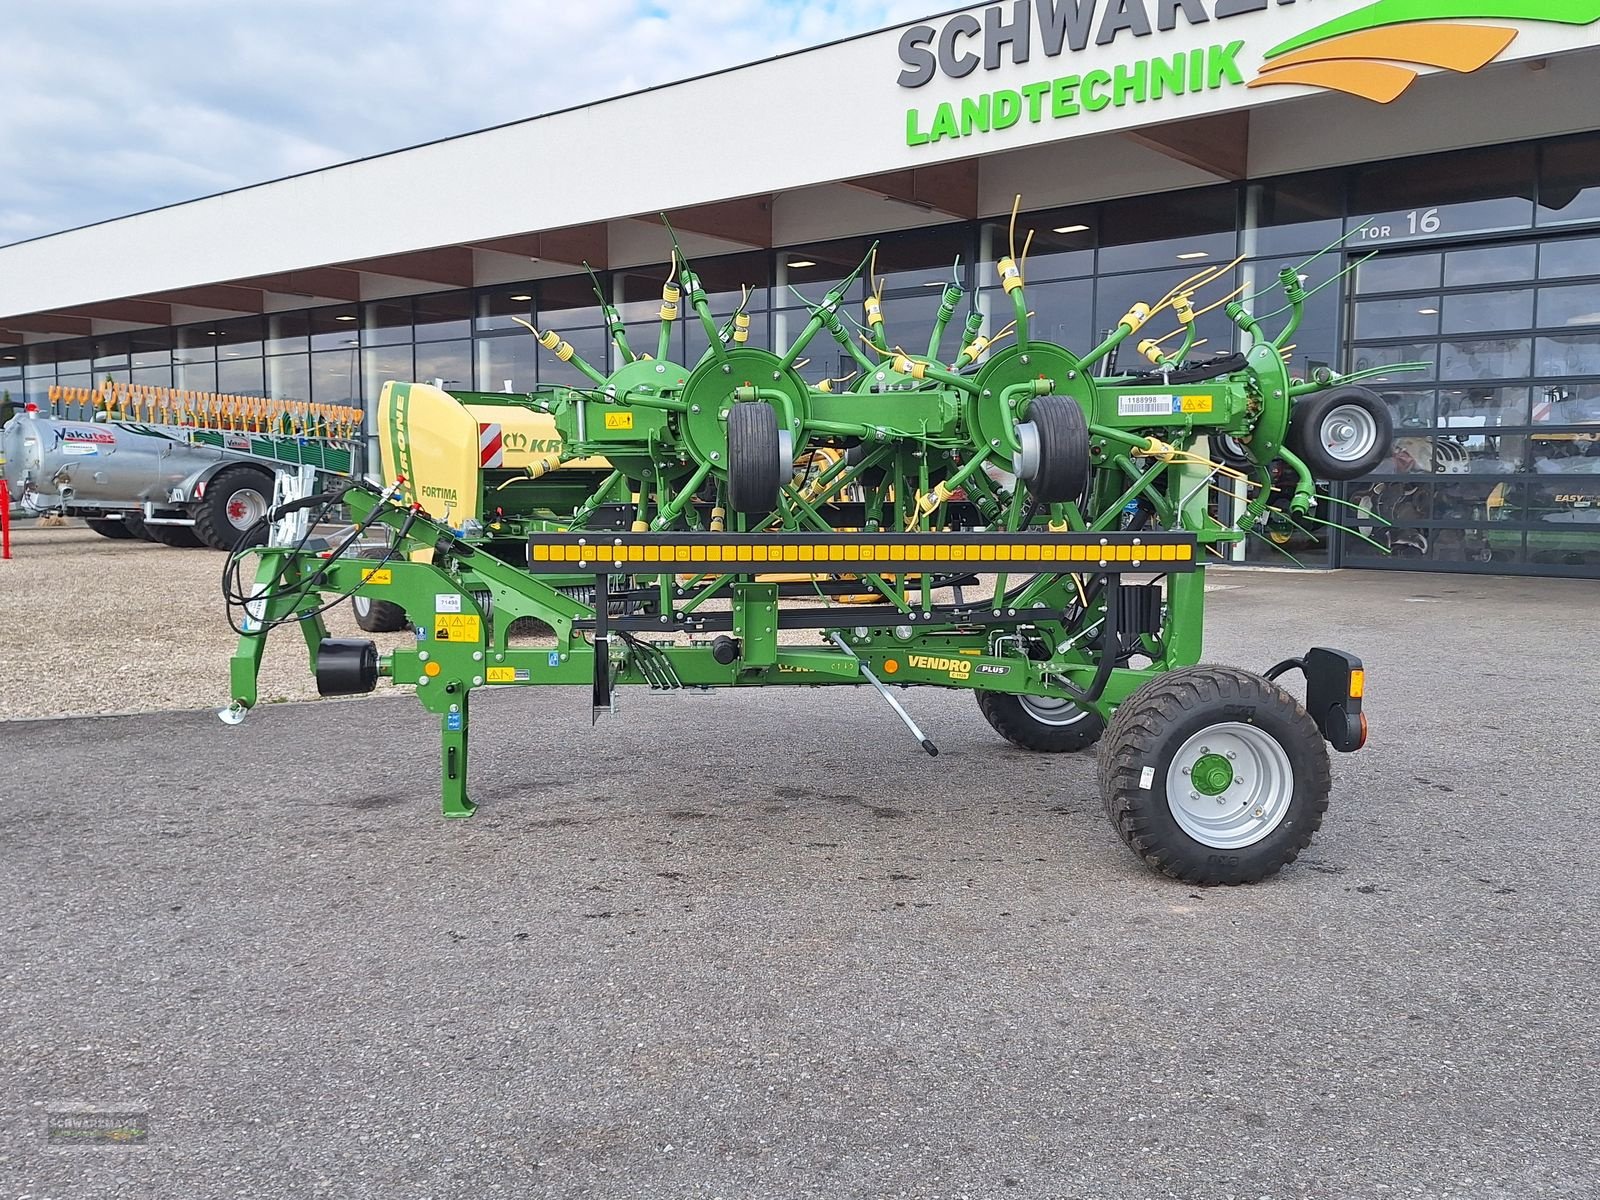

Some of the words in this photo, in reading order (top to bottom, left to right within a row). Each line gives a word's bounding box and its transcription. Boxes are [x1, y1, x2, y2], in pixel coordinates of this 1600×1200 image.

[906, 40, 1245, 146] LANDTECHNIK
[1360, 225, 1391, 239] TOR
[1406, 208, 1440, 234] 16
[53, 427, 115, 441] Vakutec
[421, 485, 457, 500] FORTIMA
[908, 655, 971, 673] VENDRO
[981, 665, 1004, 674] PLUS
